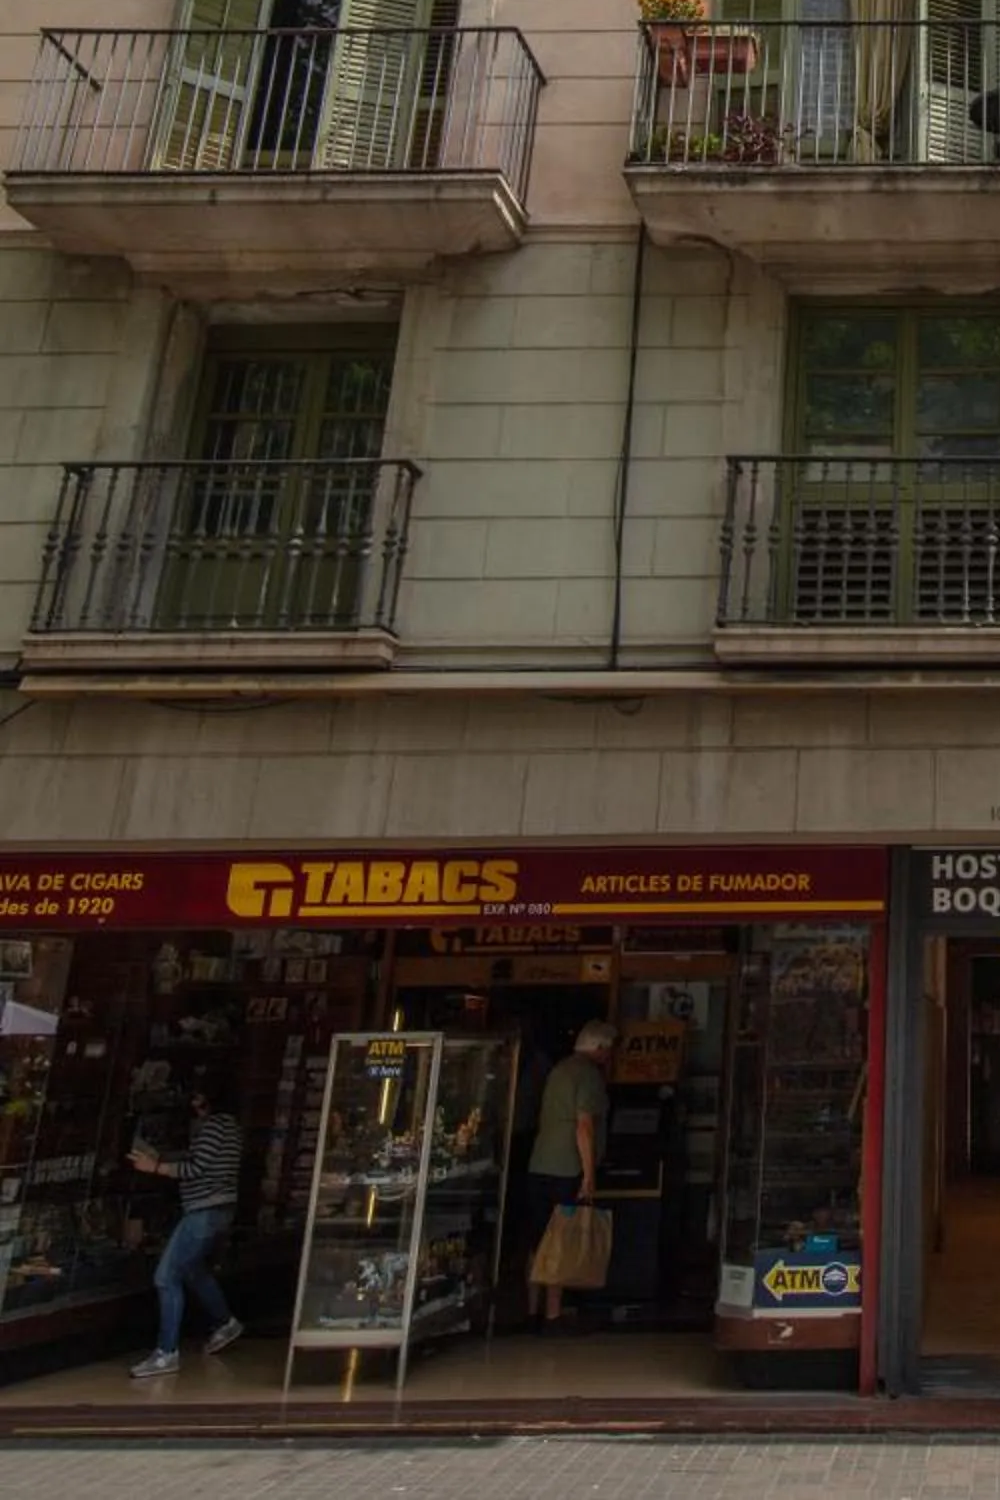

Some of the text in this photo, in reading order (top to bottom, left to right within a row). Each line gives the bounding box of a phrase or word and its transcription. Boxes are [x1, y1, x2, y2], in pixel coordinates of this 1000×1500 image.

[37, 873, 65, 891] DE
[70, 872, 145, 891] CIGARS
[300, 859, 519, 904] TABACS
[580, 873, 811, 893] ARTICLES DE FUMADOR
[34, 897, 60, 915] de
[67, 896, 115, 915] 1920
[368, 1040, 405, 1056] ATM
[772, 1269, 821, 1290] ATM
